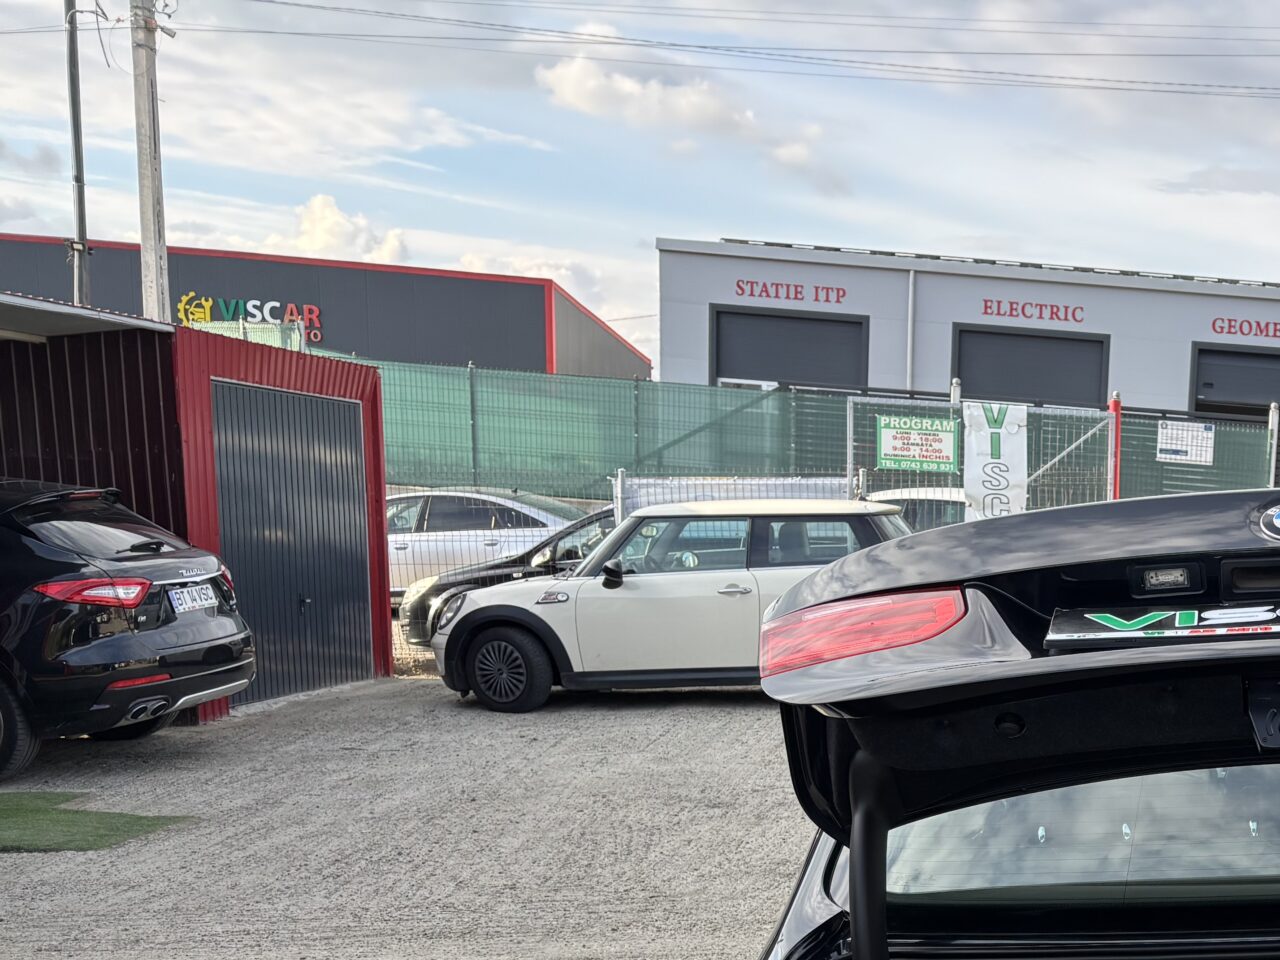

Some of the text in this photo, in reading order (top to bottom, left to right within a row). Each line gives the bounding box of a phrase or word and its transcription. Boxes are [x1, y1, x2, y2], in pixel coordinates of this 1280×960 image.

[735, 279, 846, 304] STATIE ITP
[217, 298, 321, 328] VISCAR
[982, 298, 1084, 323] ELECTRIC
[881, 416, 954, 431] PROGRAM
[174, 586, 213, 606] BT 14 VSC
